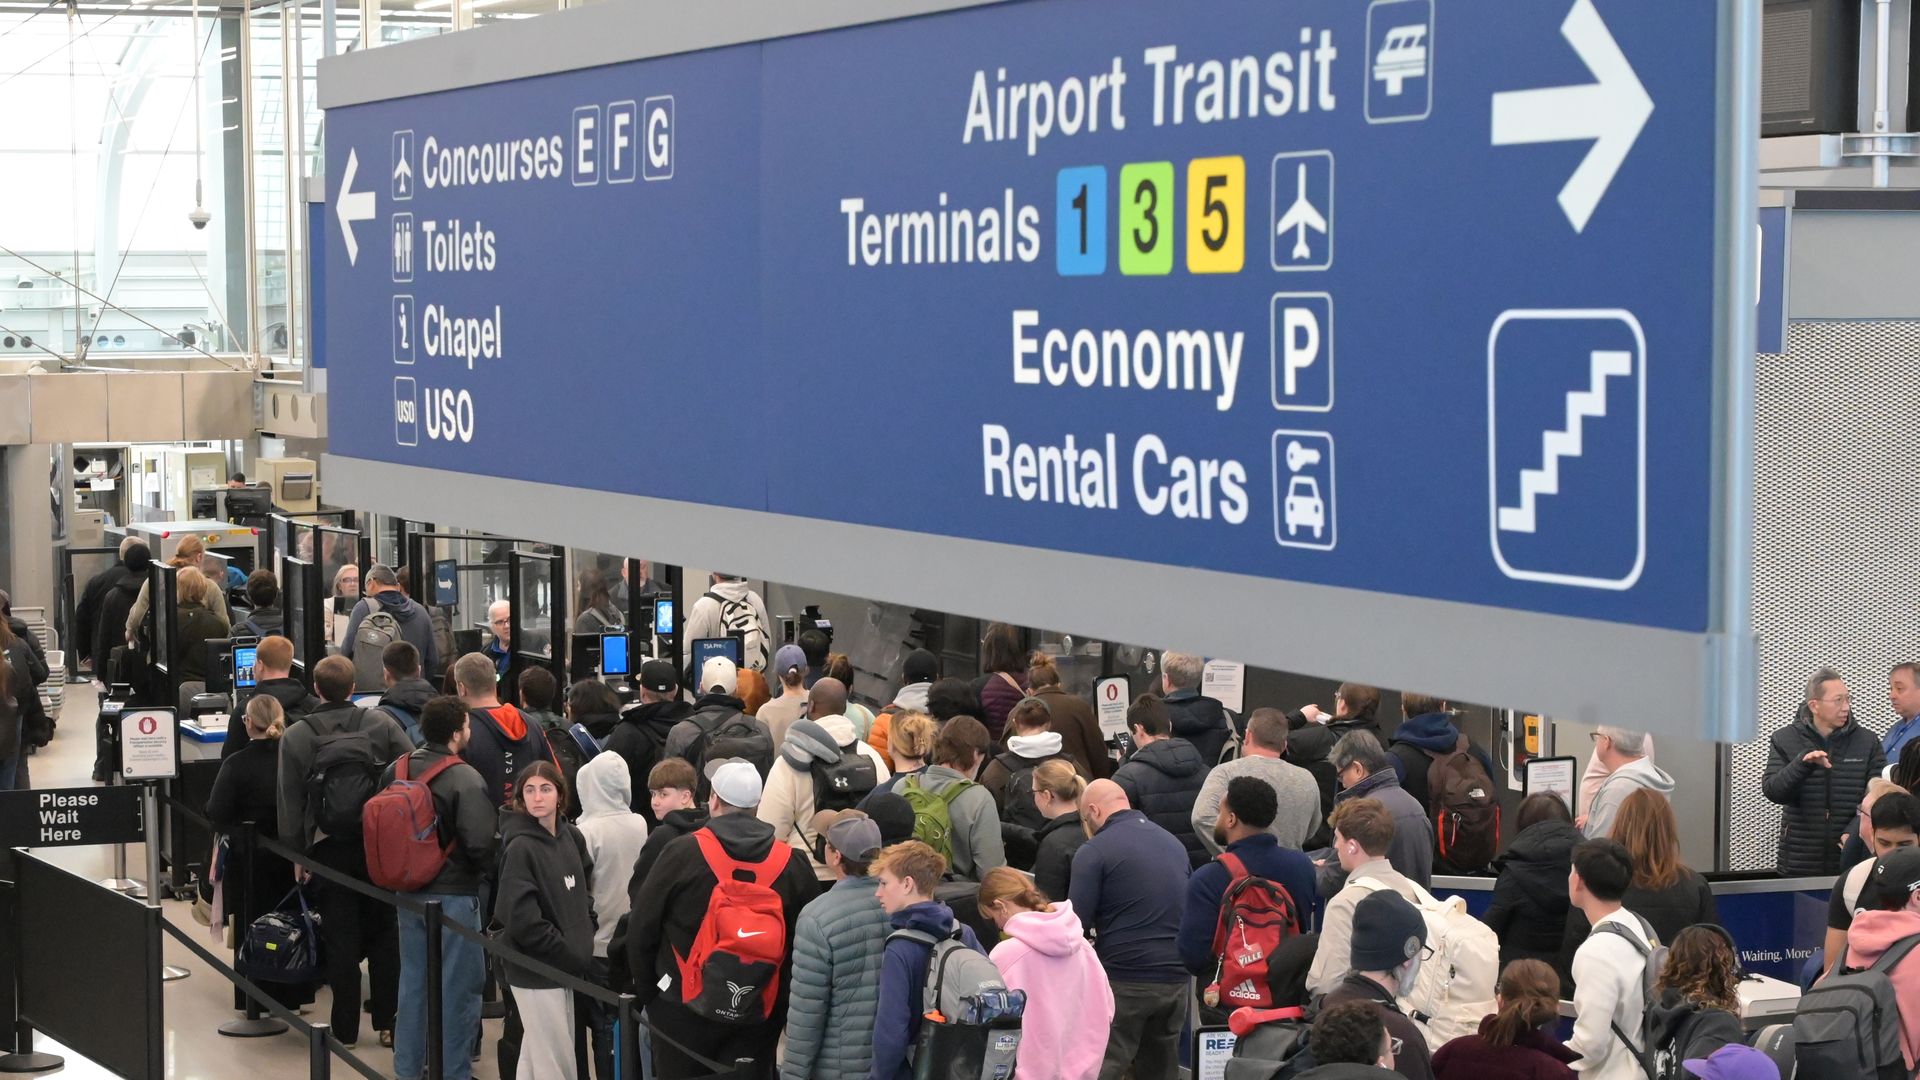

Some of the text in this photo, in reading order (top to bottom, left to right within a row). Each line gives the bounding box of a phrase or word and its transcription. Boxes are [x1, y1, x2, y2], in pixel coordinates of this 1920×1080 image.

[962, 27, 1337, 156] Airport Transit
[422, 107, 669, 189] Concourses E F G
[422, 219, 496, 272] Toilets
[840, 175, 1229, 266] Terminals 1 3 5
[423, 303, 502, 370] Chapel
[1012, 307, 1320, 411] Economy P
[396, 387, 474, 443] USO USO
[982, 423, 1249, 524] Rental Cars
[39, 793, 99, 808] Please
[39, 810, 79, 825] Wait
[40, 827, 82, 842] Here
[1741, 949, 1783, 963] Waiting,
[1785, 948, 1812, 960] More
[1229, 990, 1261, 1000] adidas
